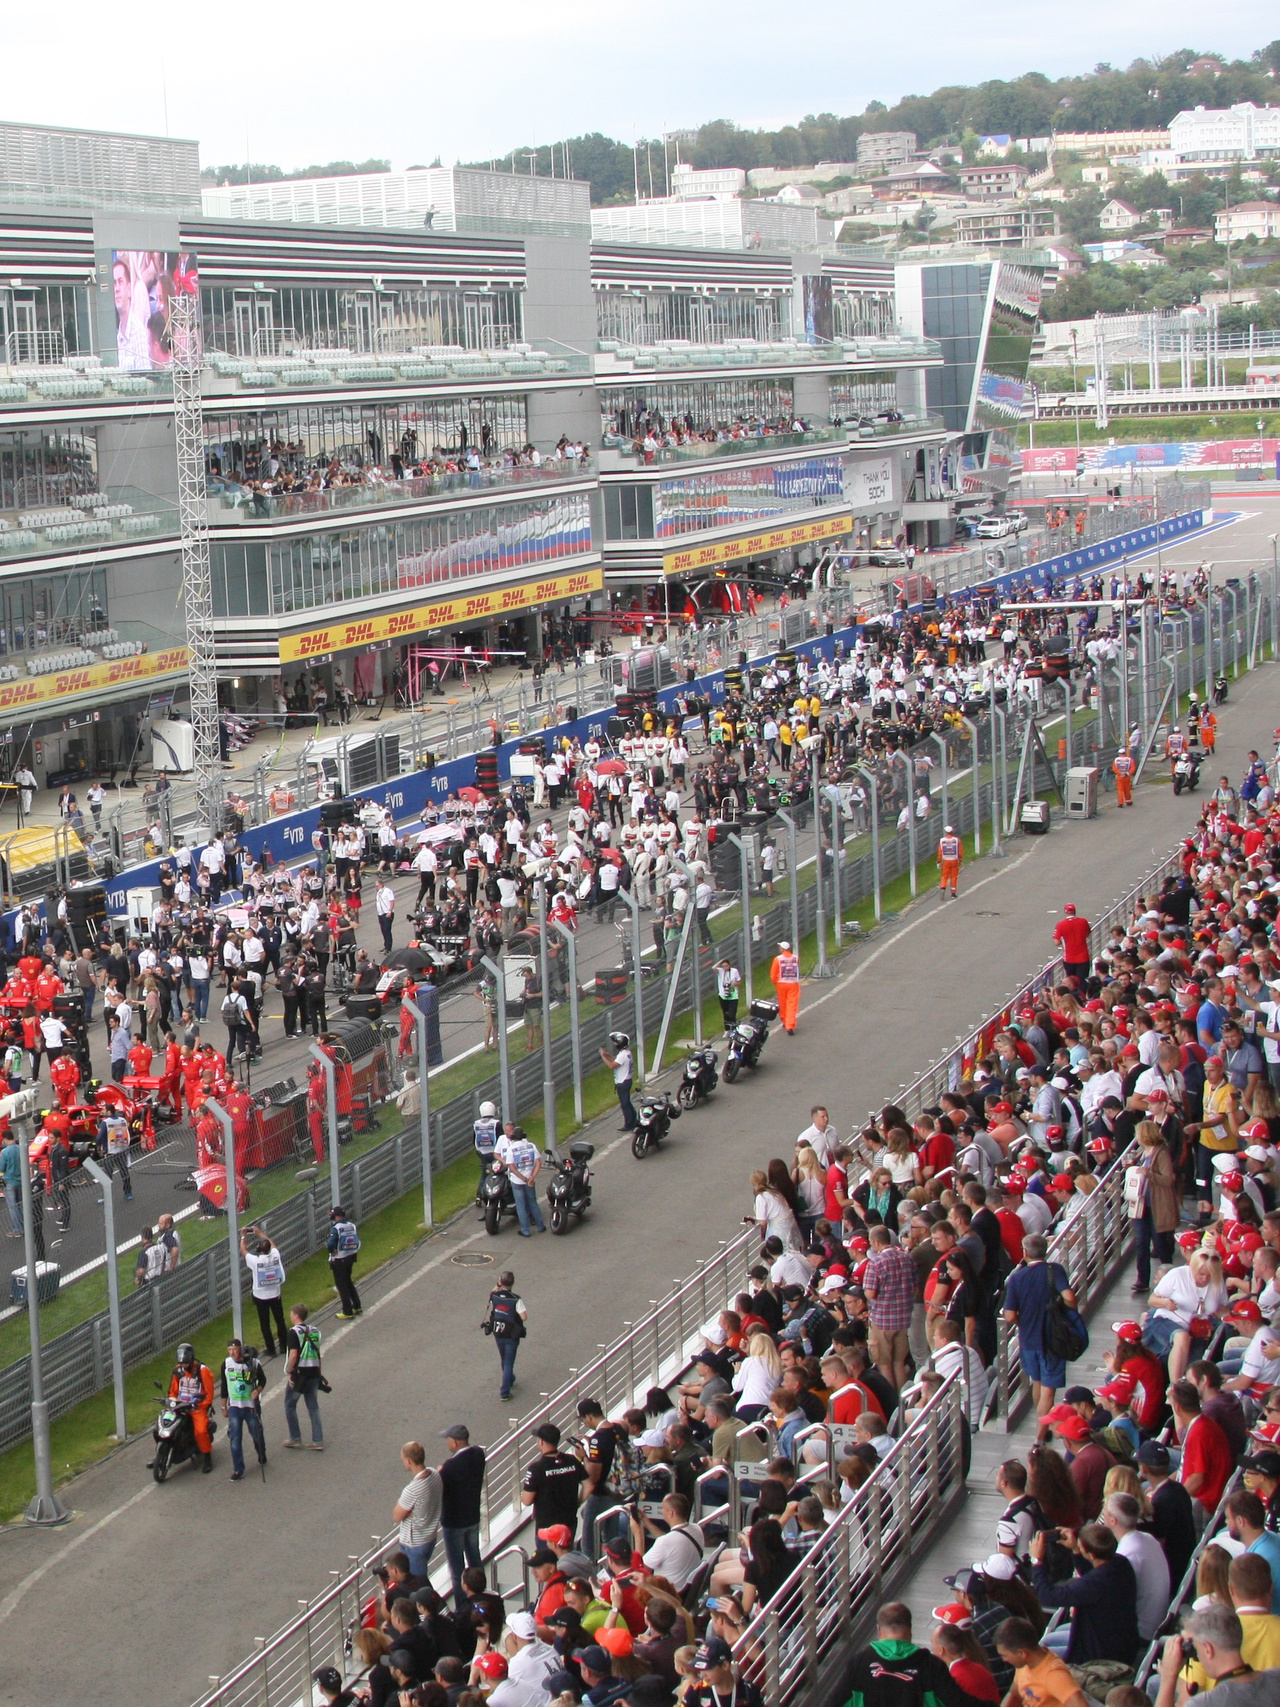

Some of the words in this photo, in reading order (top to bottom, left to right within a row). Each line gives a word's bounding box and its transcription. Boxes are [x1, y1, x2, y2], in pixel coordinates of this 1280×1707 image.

[863, 472, 879, 484] THANK
[880, 469, 890, 482] YOU
[868, 486, 886, 500] SOCHI
[535, 582, 558, 600] DHL
[568, 575, 590, 593] DHL
[465, 597, 491, 616] DHL
[501, 589, 527, 608] DHL
[388, 613, 416, 635] DHL
[428, 605, 455, 625] DHL
[345, 621, 375, 645] DHL
[299, 631, 331, 655] DHL
[157, 650, 188, 671] DHL
[109, 659, 143, 682] DHL
[56, 671, 92, 694] DHL
[0, 682, 40, 706] DHL
[435, 776, 449, 793] VTB
[389, 792, 404, 810] VTB
[289, 827, 304, 846] VTB
[107, 890, 126, 909] VTB
[834, 1427, 844, 1437] 4
[545, 1465, 576, 1477] PETRONAS
[739, 1465, 749, 1475] 3
[642, 1505, 653, 1515] 2
